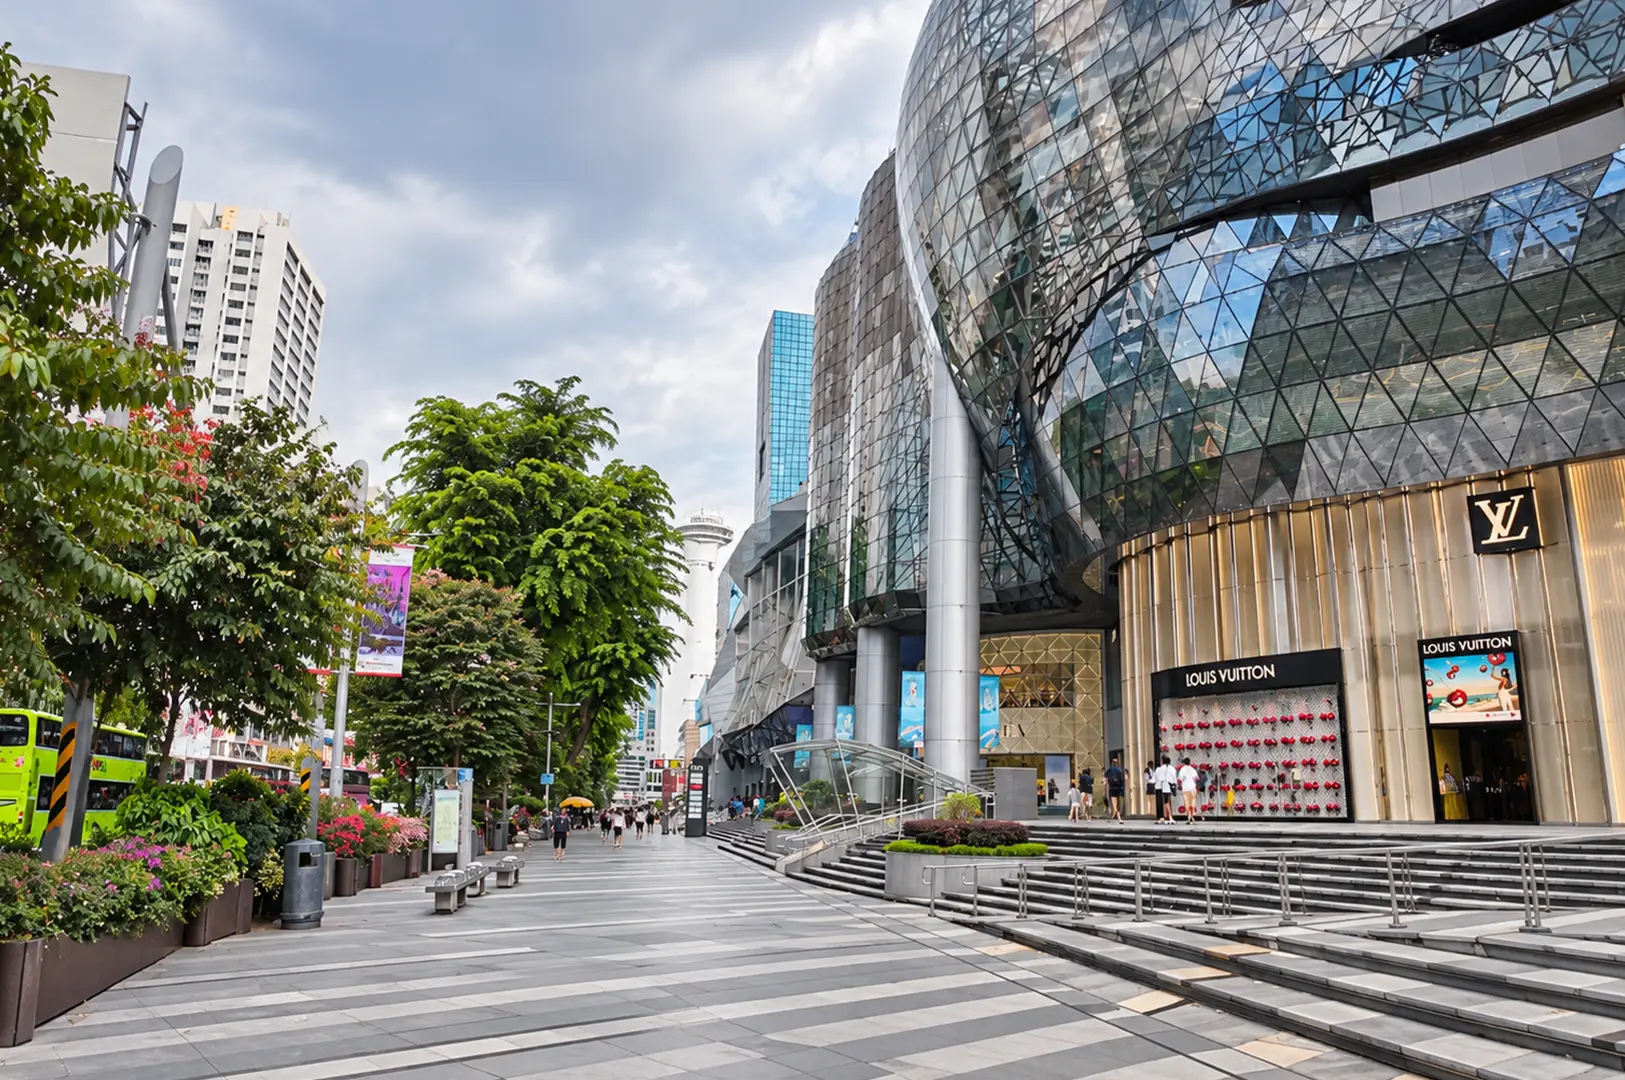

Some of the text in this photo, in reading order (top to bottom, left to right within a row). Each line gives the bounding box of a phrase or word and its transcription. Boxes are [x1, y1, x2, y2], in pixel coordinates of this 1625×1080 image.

[1475, 494, 1529, 545] LV
[1423, 636, 1512, 655] LOUIS VUITTON
[1185, 664, 1276, 688] LOUIS VUITTON
